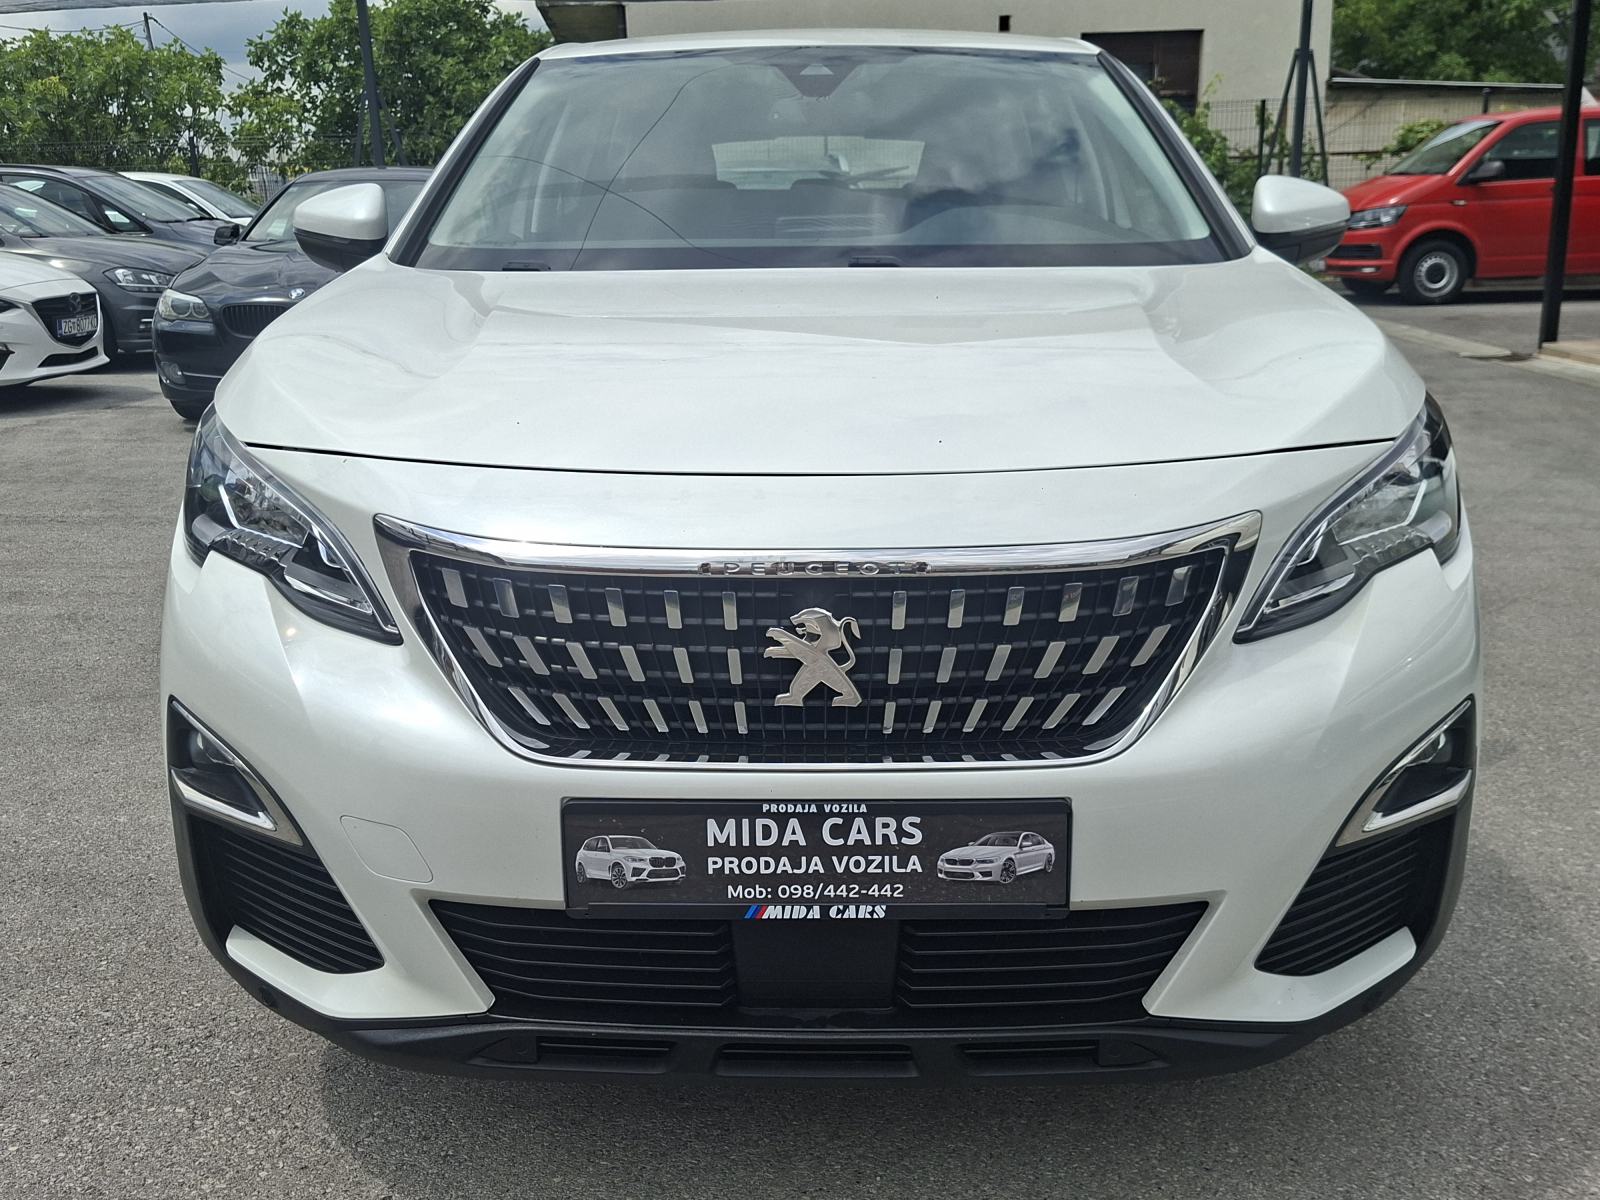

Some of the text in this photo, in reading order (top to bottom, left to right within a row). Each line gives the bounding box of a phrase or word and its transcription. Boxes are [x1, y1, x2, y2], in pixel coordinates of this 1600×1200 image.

[63, 319, 73, 334] ZG
[723, 562, 909, 576] PEUGEOT
[762, 803, 868, 813] PRODAJA VOZILA
[706, 816, 923, 847] MIDA CARS
[707, 854, 923, 875] PRODAJA VOZILA
[727, 882, 904, 900] Mob: 098/442-442
[761, 904, 887, 919] MIDA CARS
